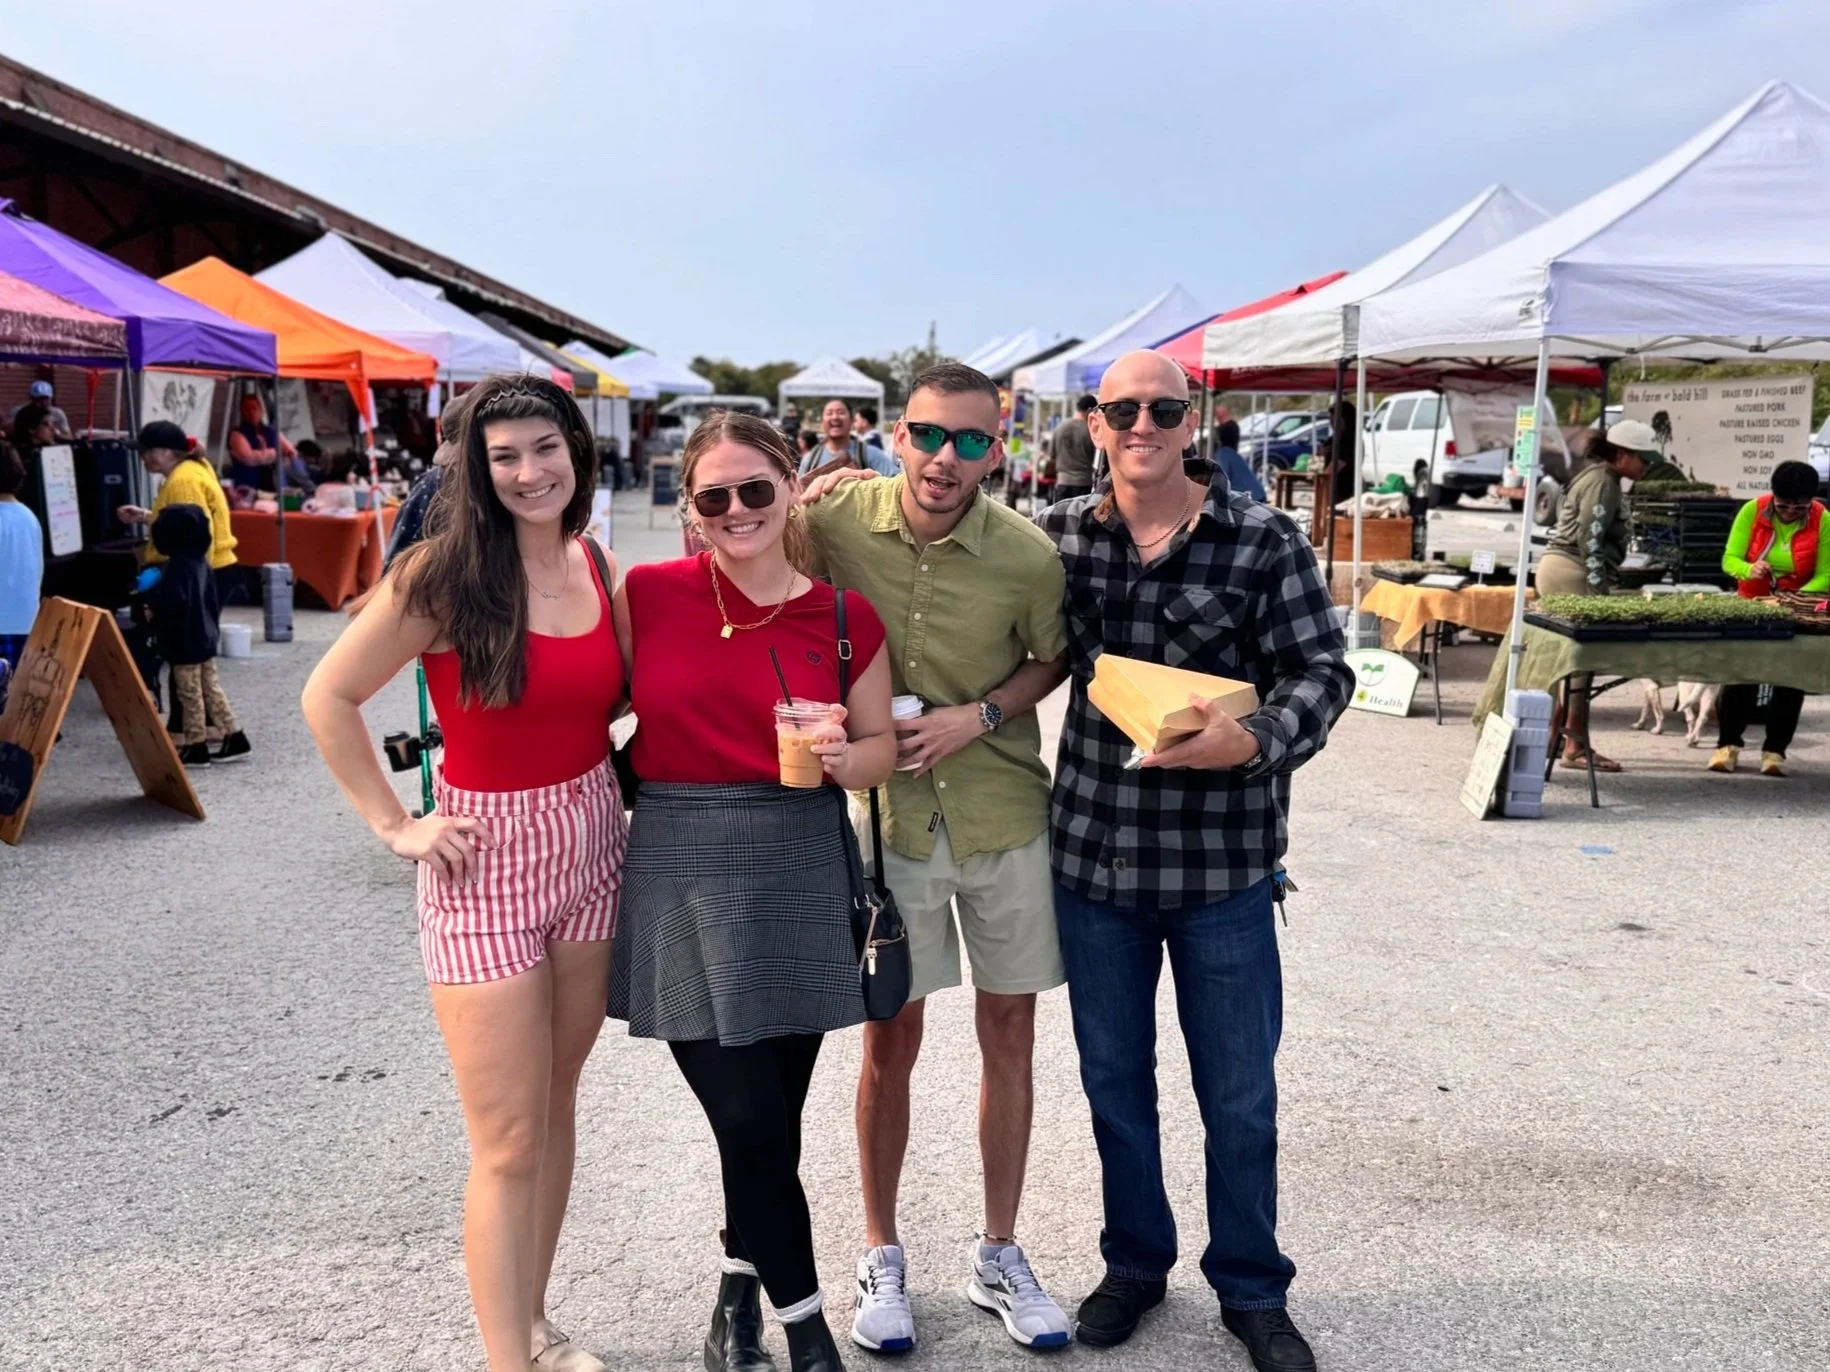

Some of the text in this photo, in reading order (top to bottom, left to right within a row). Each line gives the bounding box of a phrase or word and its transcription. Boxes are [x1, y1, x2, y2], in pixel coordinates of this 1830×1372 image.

[1627, 389, 1639, 402] the
[1641, 389, 1661, 402] farm
[1693, 387, 1708, 401] hill
[1790, 385, 1806, 395] BEEF
[1767, 402, 1786, 412] PORK
[1719, 418, 1801, 428] PASTURE RAISED CHICKEN
[1734, 434, 1784, 444] PASTURED EGGS
[1742, 450, 1774, 459] NON GMO
[1743, 466, 1757, 475] NON
[1736, 481, 1746, 490] ALL
[1369, 695, 1403, 708] Health
